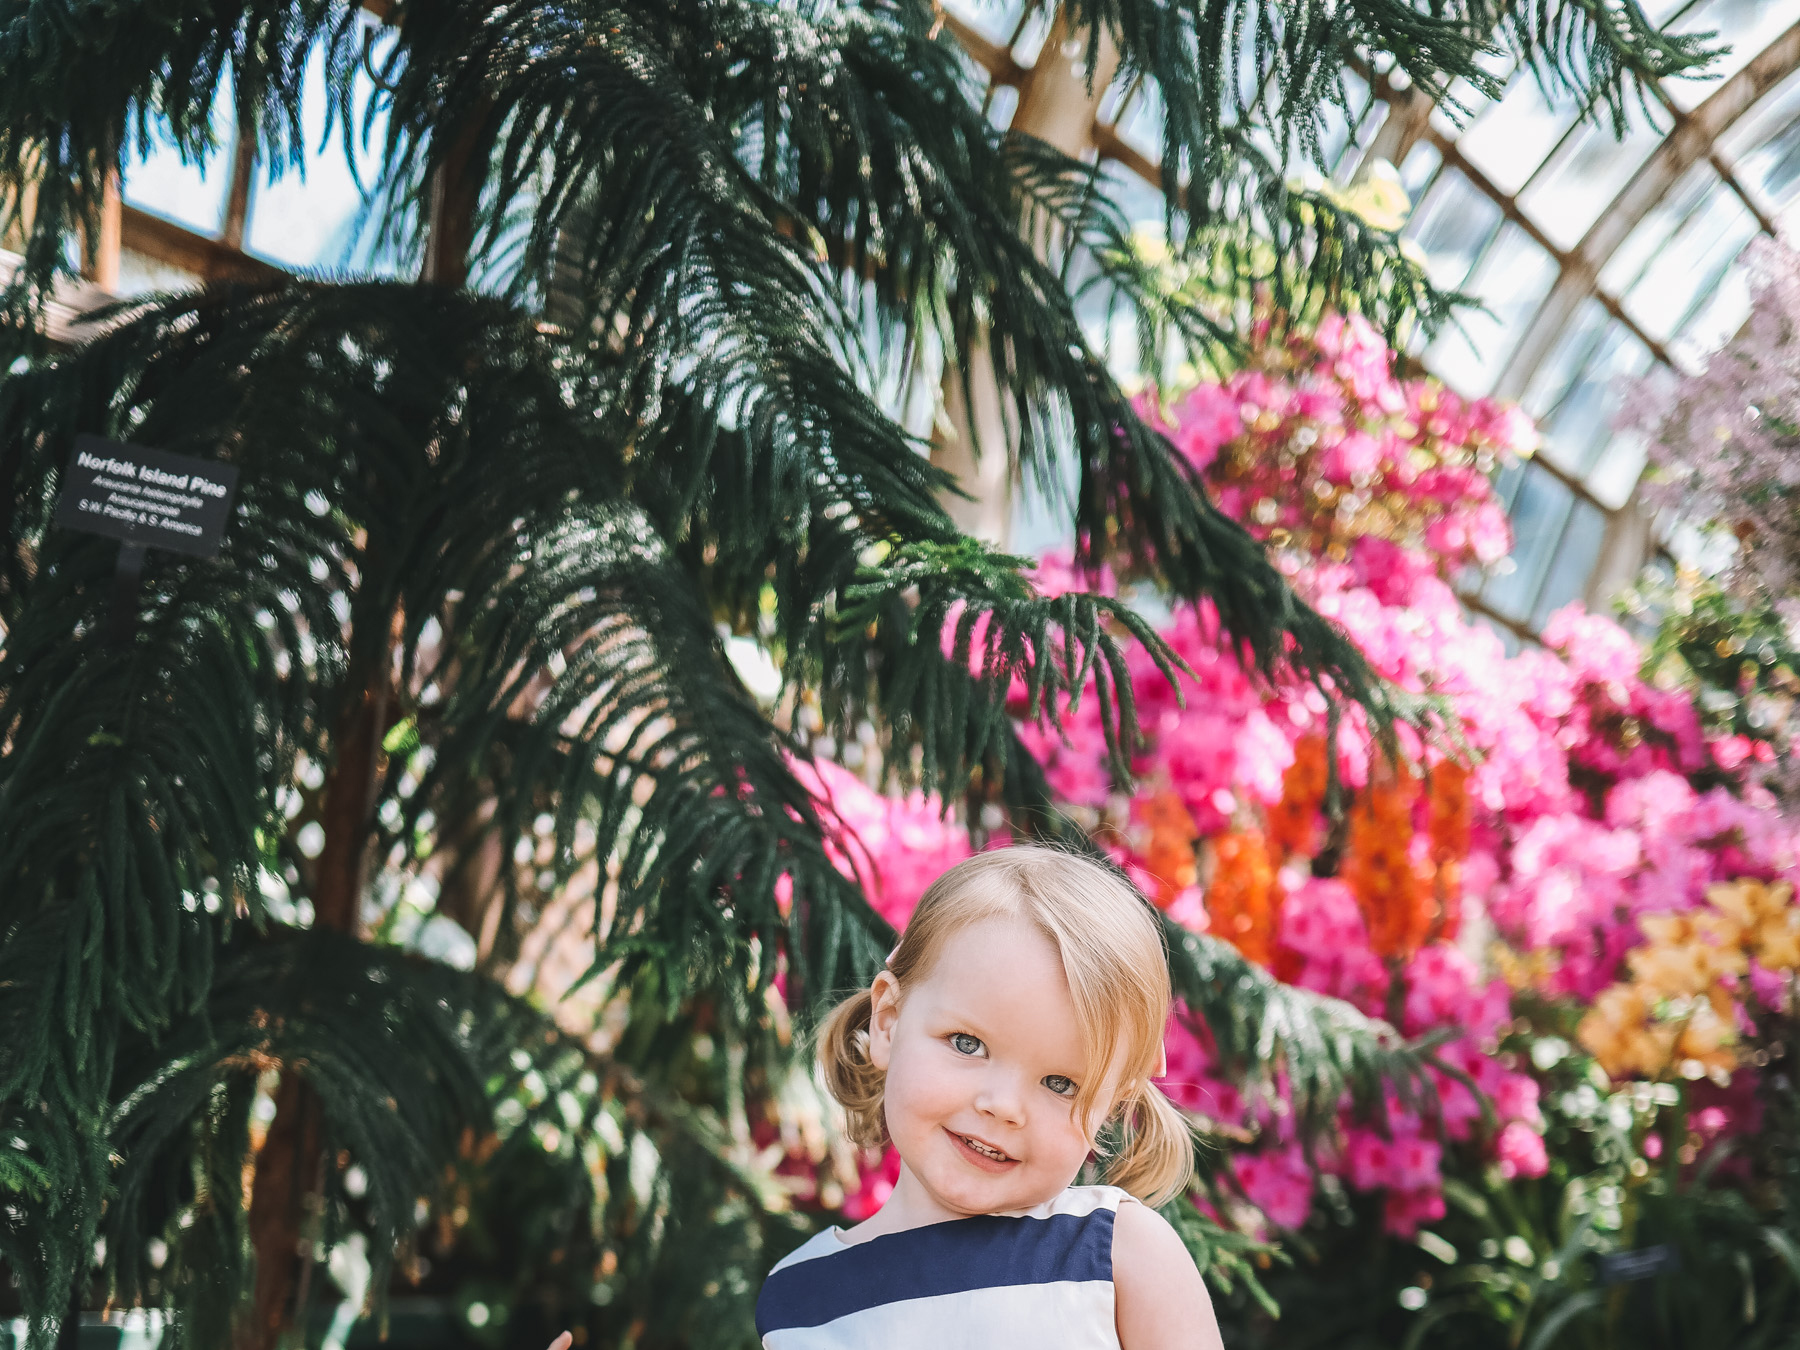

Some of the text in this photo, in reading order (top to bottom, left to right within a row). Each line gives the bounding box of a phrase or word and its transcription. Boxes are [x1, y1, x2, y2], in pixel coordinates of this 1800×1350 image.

[77, 451, 227, 498] Norfolk Island Pine
[103, 503, 138, 522] Pacific
[138, 512, 148, 525] &
[160, 517, 203, 537] America
